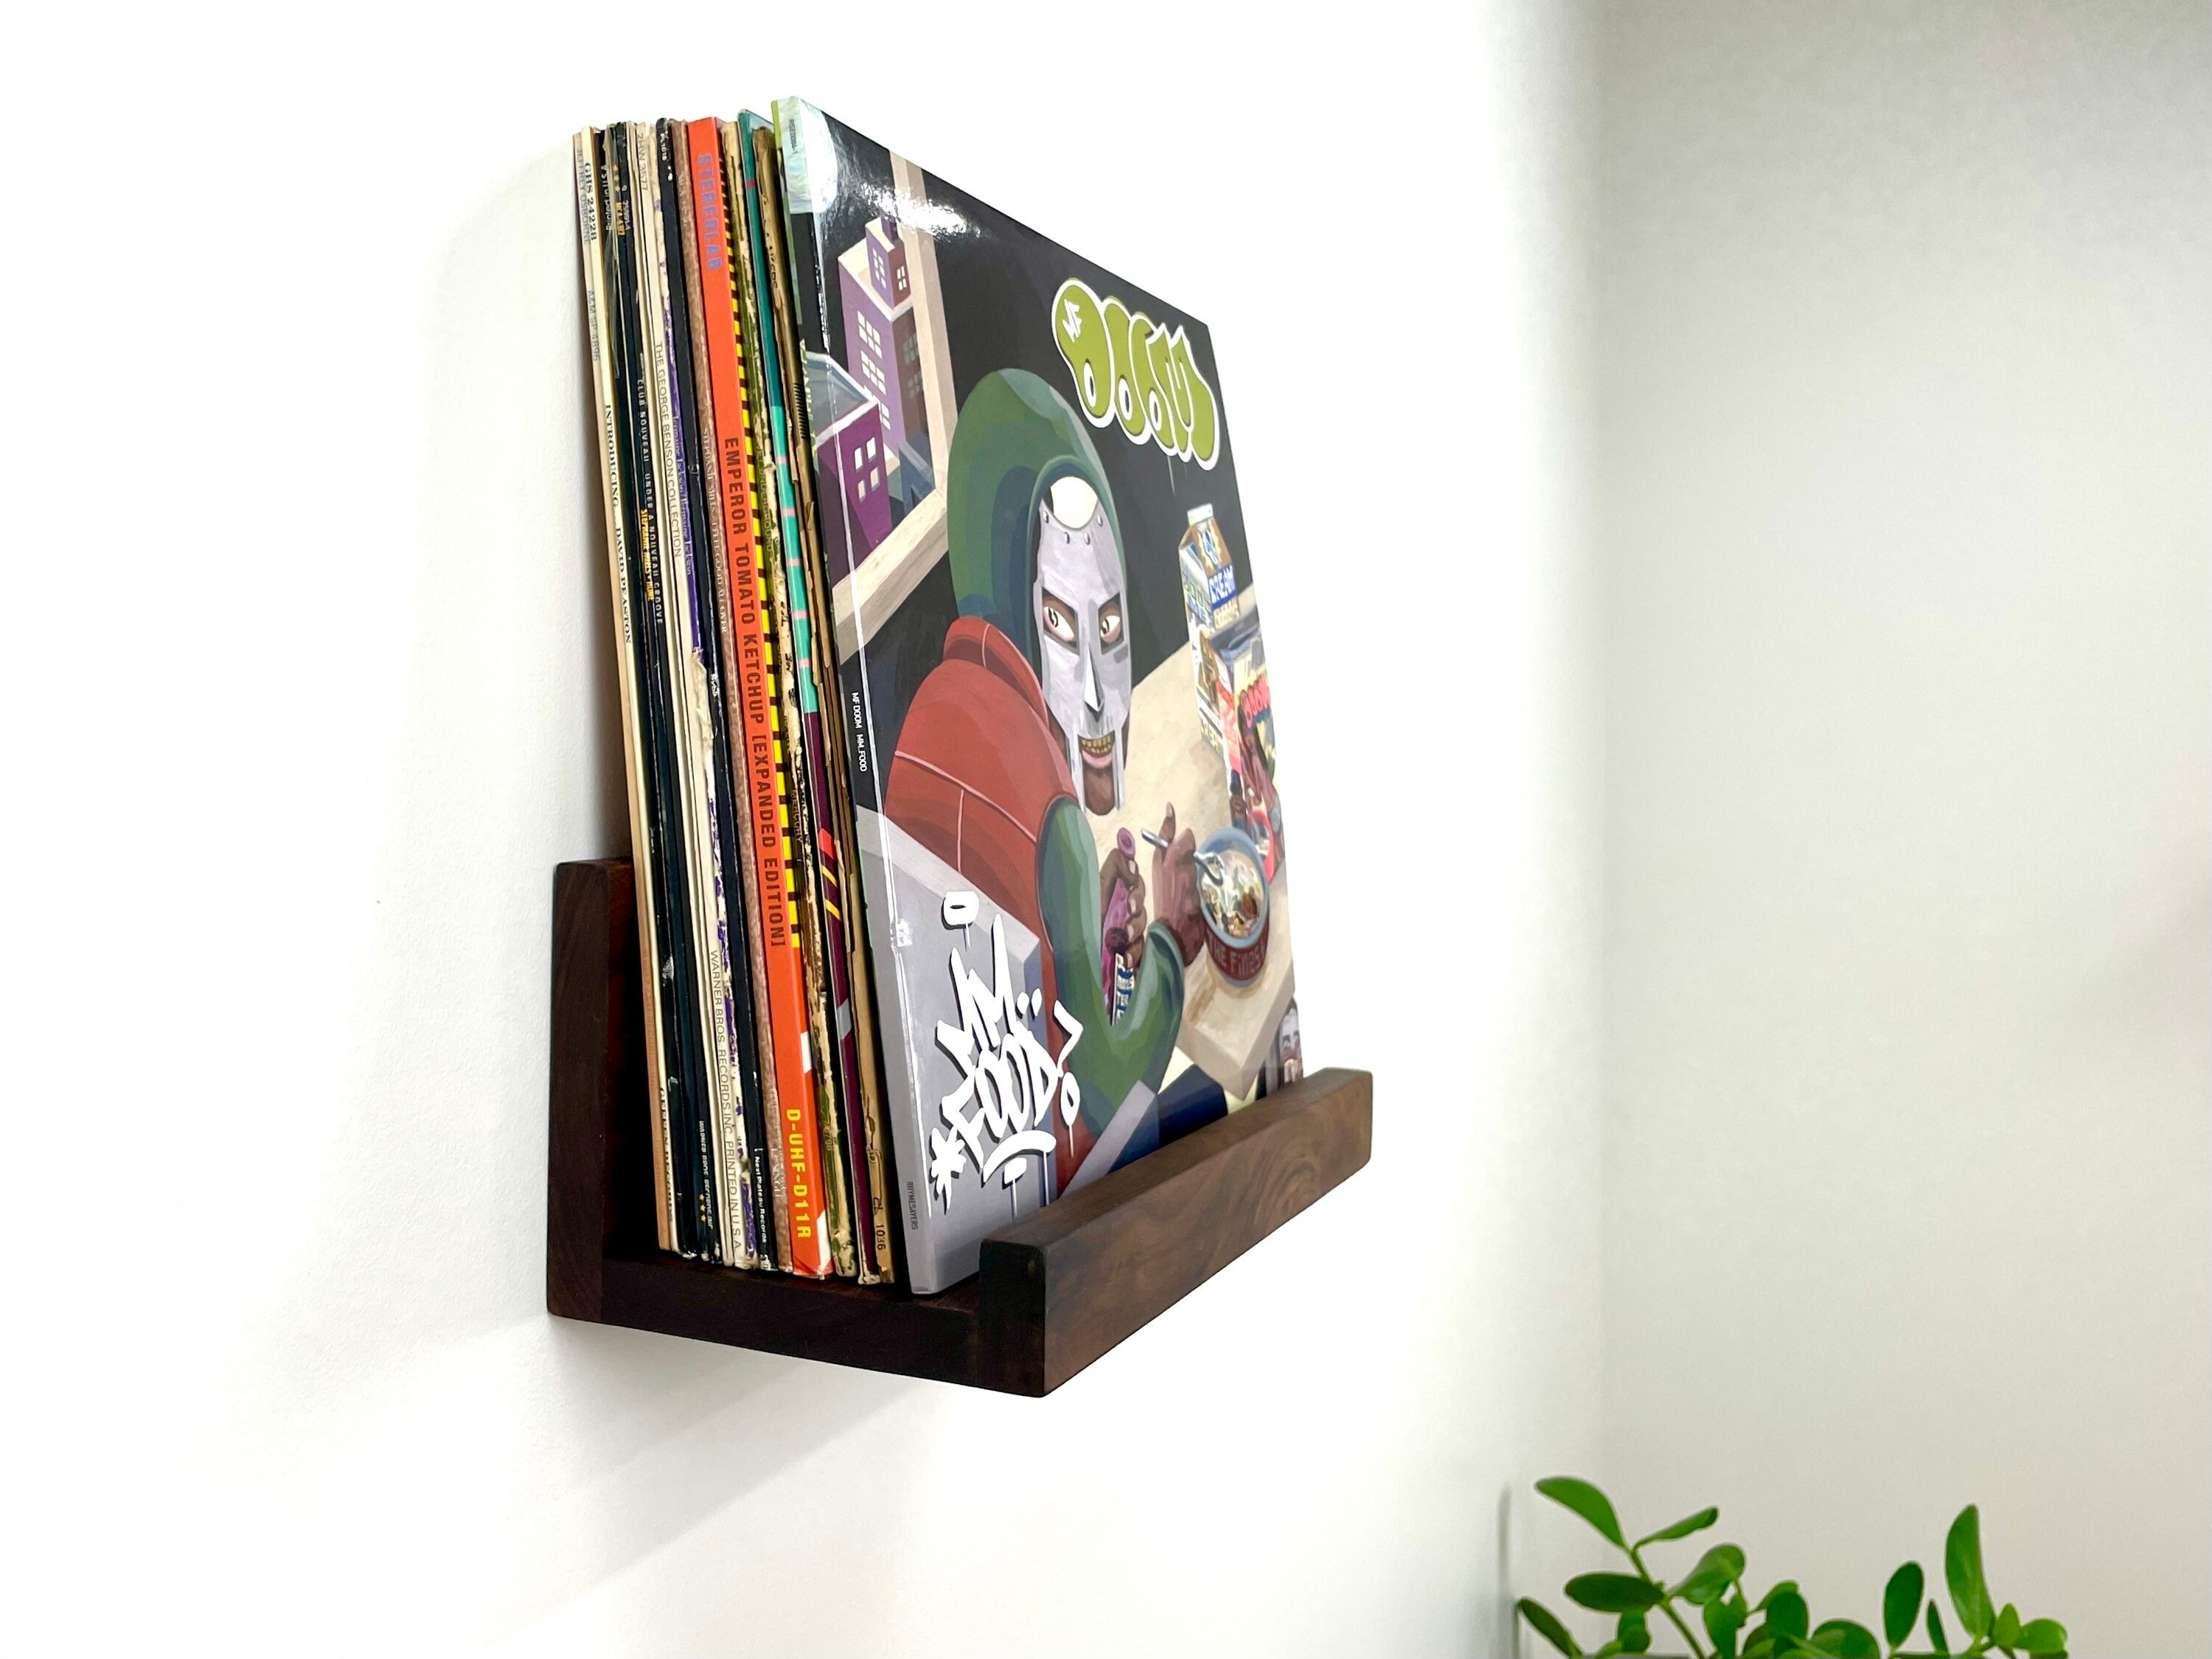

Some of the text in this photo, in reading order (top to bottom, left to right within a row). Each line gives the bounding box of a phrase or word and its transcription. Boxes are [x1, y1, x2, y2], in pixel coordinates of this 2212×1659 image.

[636, 132, 648, 191] 2HW 3577
[583, 162, 597, 241] GHS 24228
[696, 153, 723, 270] STEREOLAB
[636, 379, 645, 406] CLUB
[639, 411, 650, 462] NOUVEAU
[655, 341, 682, 557] THE GEORGE BENSON COLLECTION
[672, 415, 682, 456] Jermaine
[644, 473, 653, 509] UNDER
[758, 470, 773, 552] UNDERGROUND
[605, 404, 631, 643] INTRODUCING DAVID PEASTON
[679, 498, 691, 538] Jermaine
[648, 526, 659, 577] NOUVEAU
[683, 540, 695, 574] Jackson
[653, 582, 663, 624] GROOVE
[723, 437, 786, 947] EMPEROR TOMATO KETCHUP [EXPANDED EDITION]
[850, 692, 860, 704] MF
[852, 705, 863, 728] DOOM
[709, 949, 723, 1005] WARNER
[714, 1008, 726, 1046] BROS.
[717, 1049, 731, 1110] RECORDS
[722, 1113, 733, 1138] INC.
[725, 1141, 737, 1195] PRINTED
[753, 1155, 762, 1175] Next
[785, 1107, 813, 1239] D-UHF-D11R
[729, 1198, 739, 1212] IN
[755, 1175, 765, 1208] Plateau
[905, 1180, 918, 1231] RHYMESAYERS
[758, 1208, 768, 1243] Records
[874, 1222, 886, 1251] 1036
